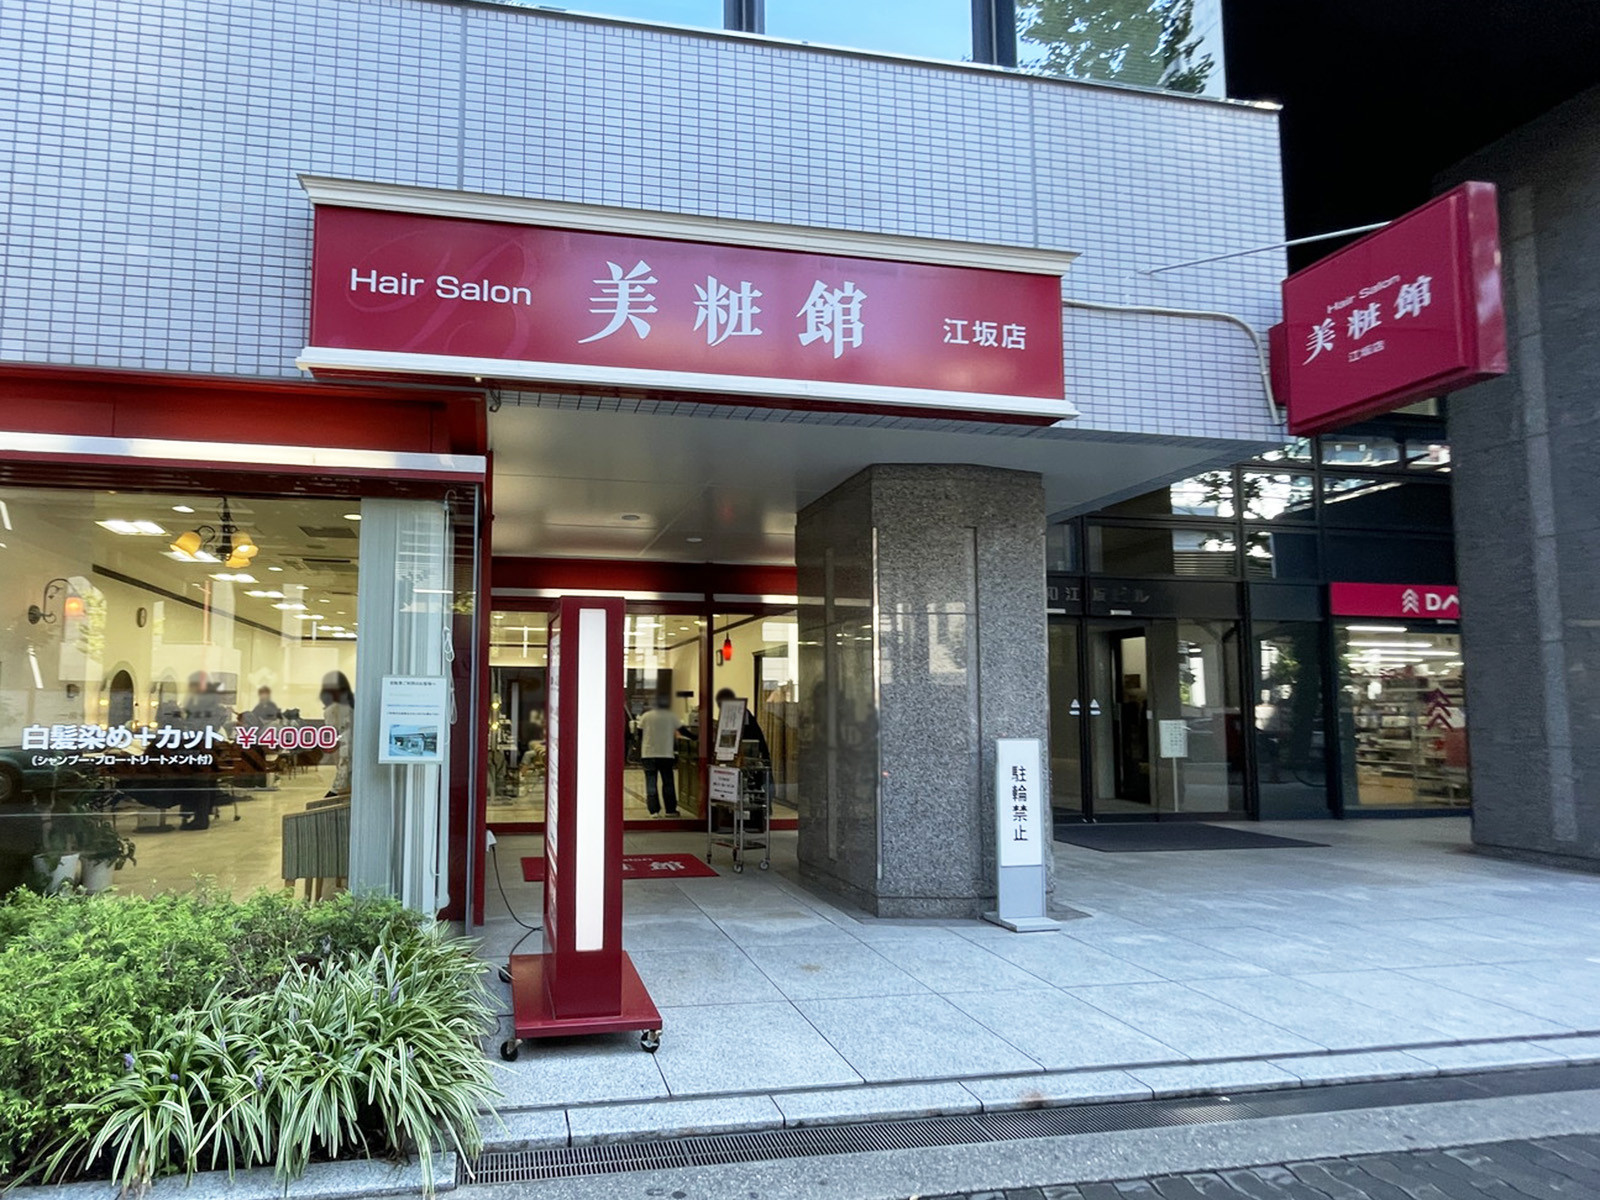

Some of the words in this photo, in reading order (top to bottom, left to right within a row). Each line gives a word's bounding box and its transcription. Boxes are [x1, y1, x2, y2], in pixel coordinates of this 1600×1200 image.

[350, 268, 425, 296] Hair
[435, 275, 532, 306] Salon
[577, 260, 868, 359] 美粧館
[943, 318, 1027, 350] 江坂店
[1302, 275, 1433, 366] 美粧館
[1326, 295, 1357, 314] Hair
[1358, 274, 1401, 299] Salon
[235, 725, 338, 749] ¥4000
[1011, 765, 1029, 841] 駐輪禁止
